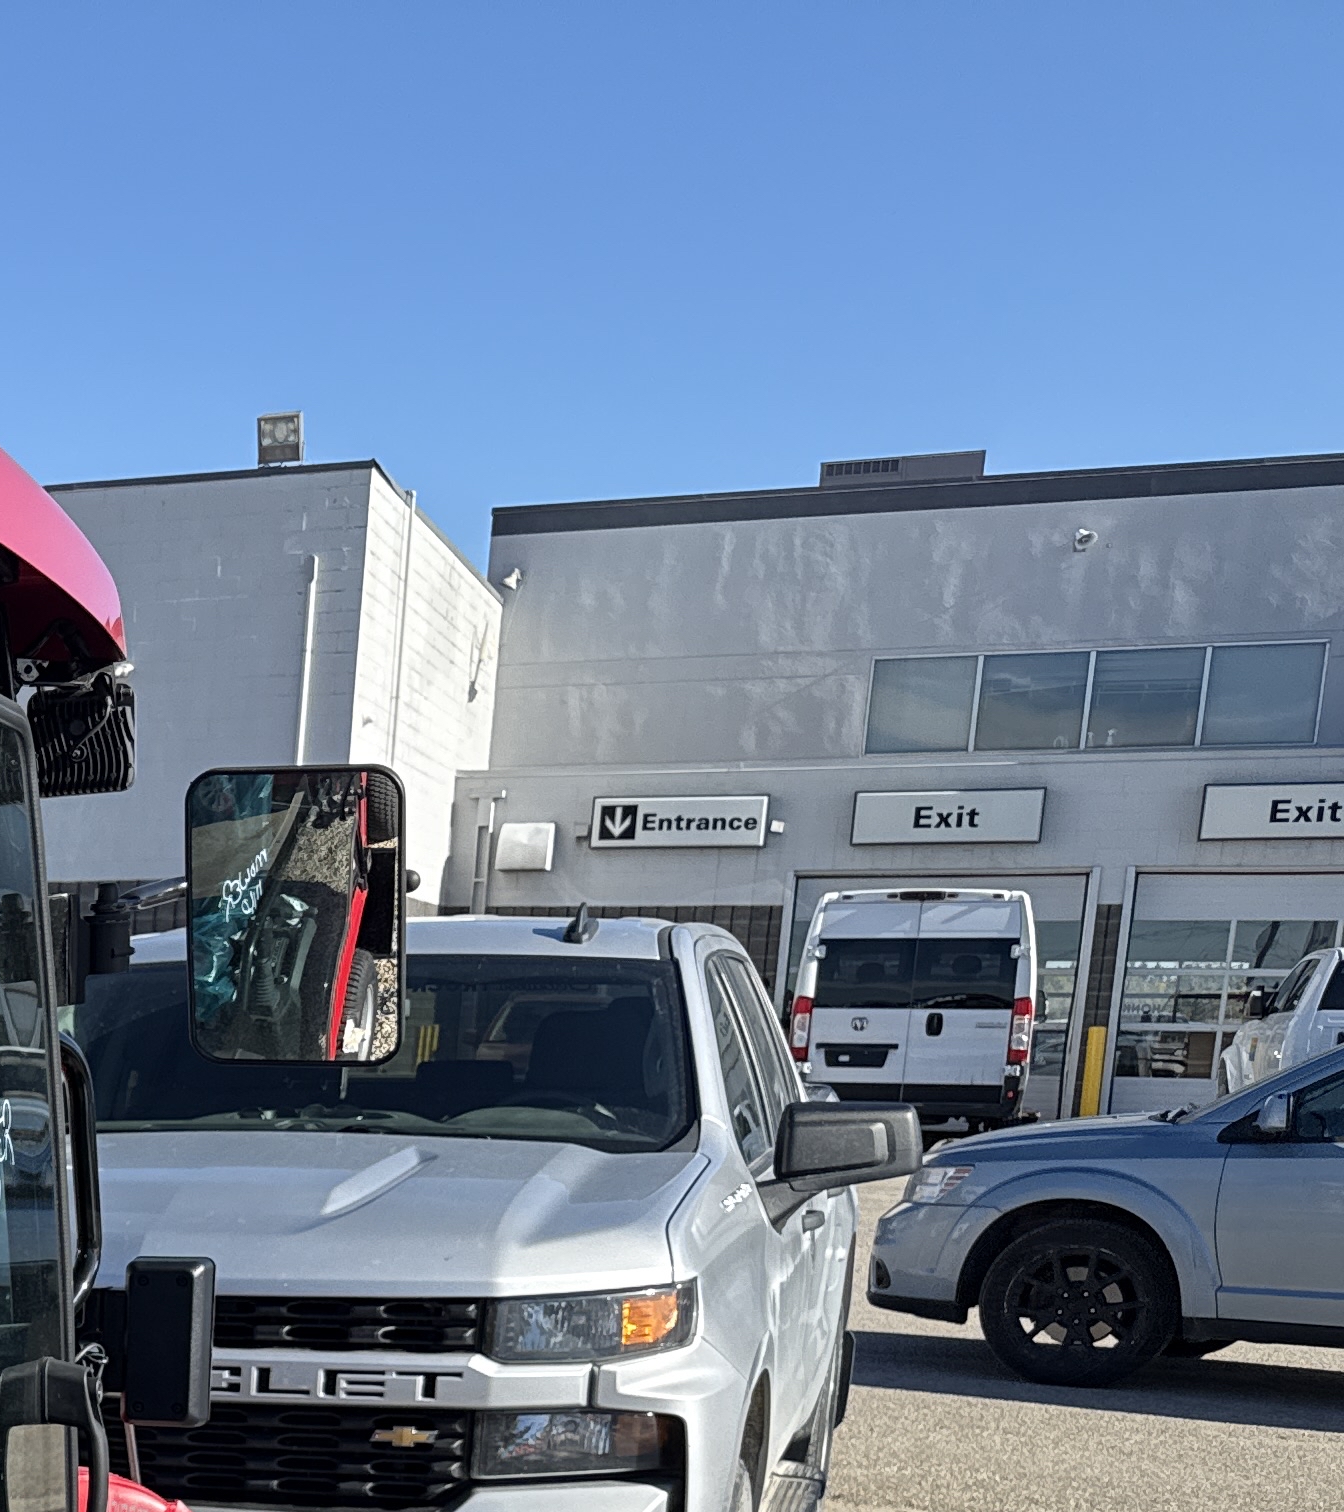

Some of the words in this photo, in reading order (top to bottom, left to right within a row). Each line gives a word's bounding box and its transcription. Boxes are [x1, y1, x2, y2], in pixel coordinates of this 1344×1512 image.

[641, 813, 758, 831] Entrance
[912, 805, 980, 829] Exit
[1269, 798, 1343, 823] Exit
